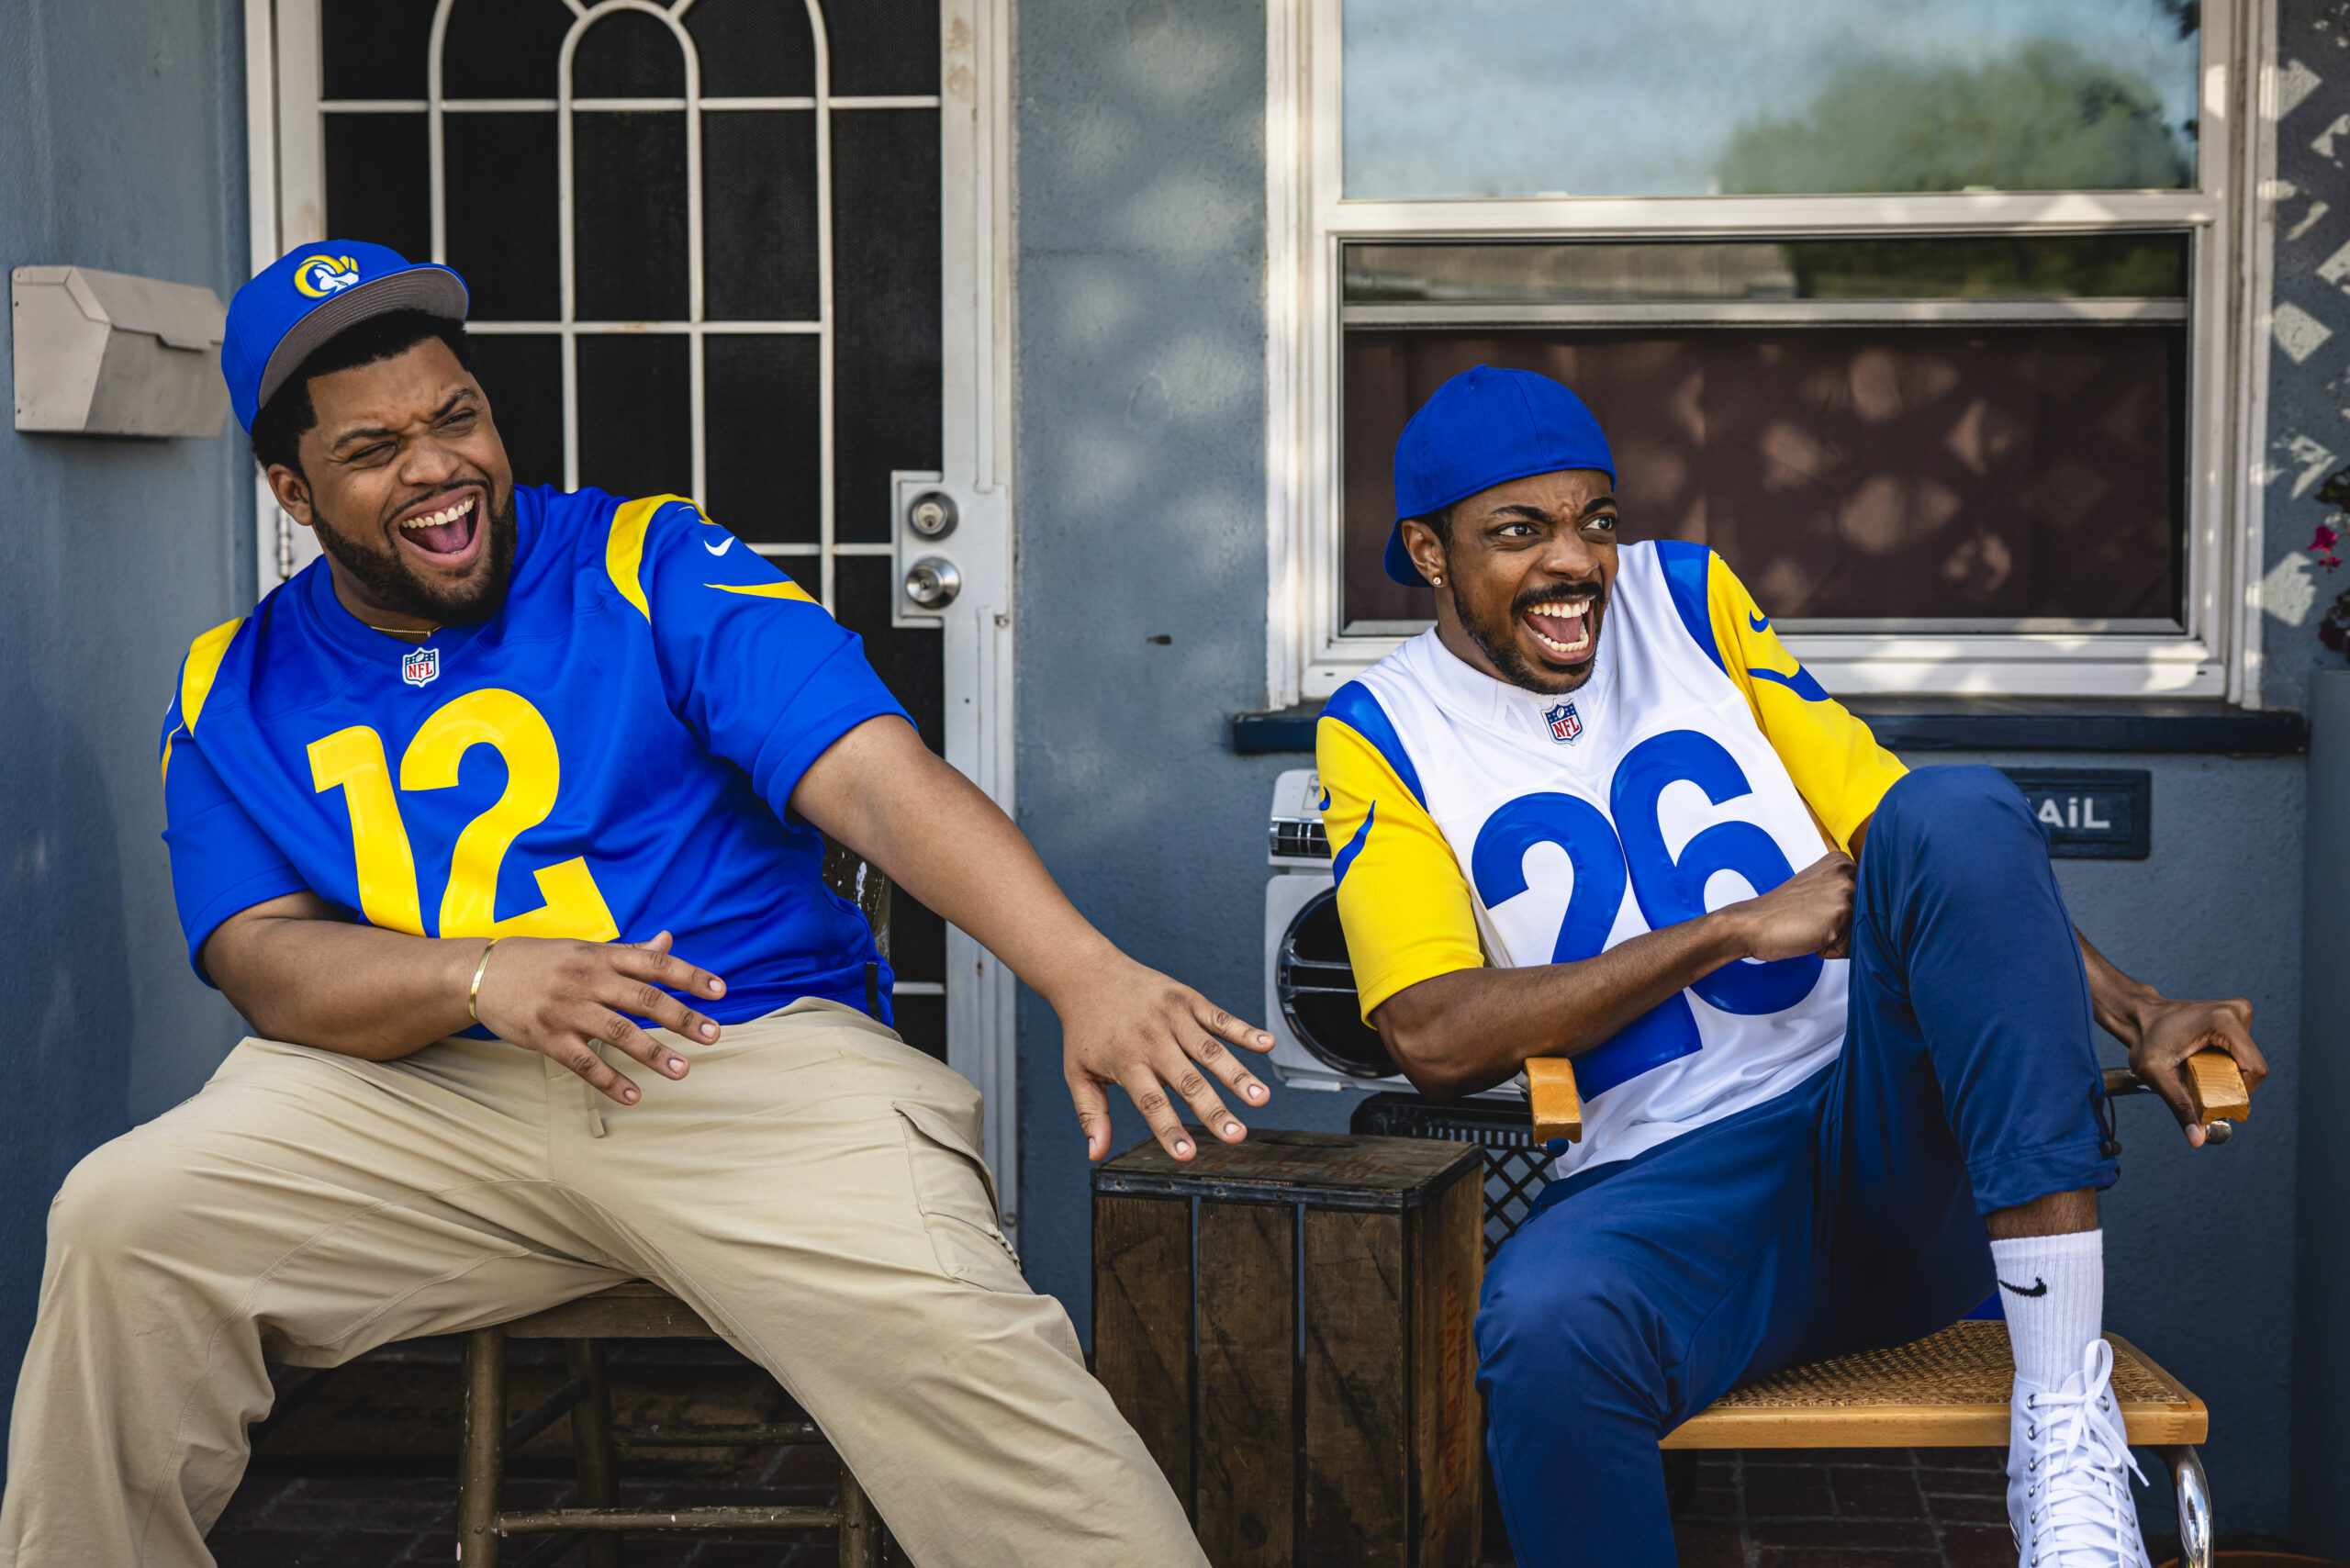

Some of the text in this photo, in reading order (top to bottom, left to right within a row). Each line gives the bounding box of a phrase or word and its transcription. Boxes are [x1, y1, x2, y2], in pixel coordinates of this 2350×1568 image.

[408, 662, 433, 678] NFL
[1551, 716, 1581, 738] NFL
[306, 688, 621, 943] 12
[2026, 797, 2111, 829] AiL
[1471, 729, 1825, 1104] 26
